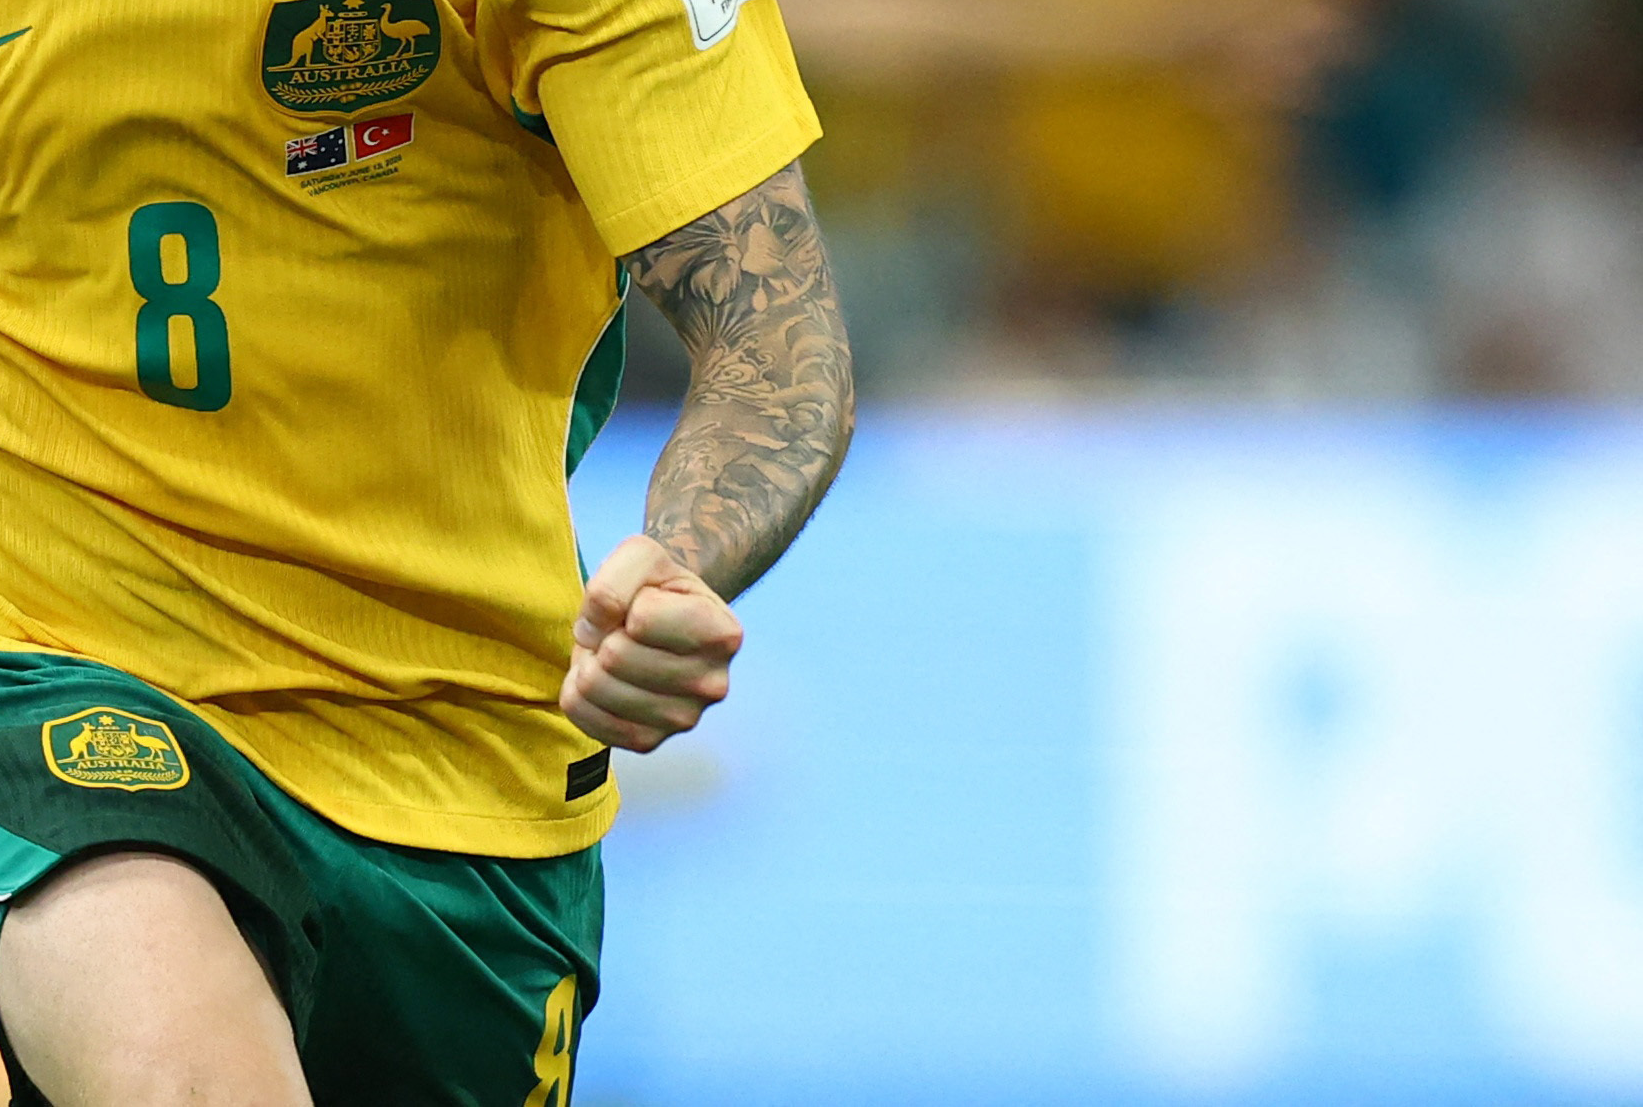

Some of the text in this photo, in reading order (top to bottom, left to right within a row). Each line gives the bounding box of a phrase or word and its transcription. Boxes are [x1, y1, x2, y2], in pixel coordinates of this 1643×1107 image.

[288, 60, 412, 85] AUSTRALIA
[128, 201, 232, 412] 8
[76, 759, 167, 771] AUSTRALIA
